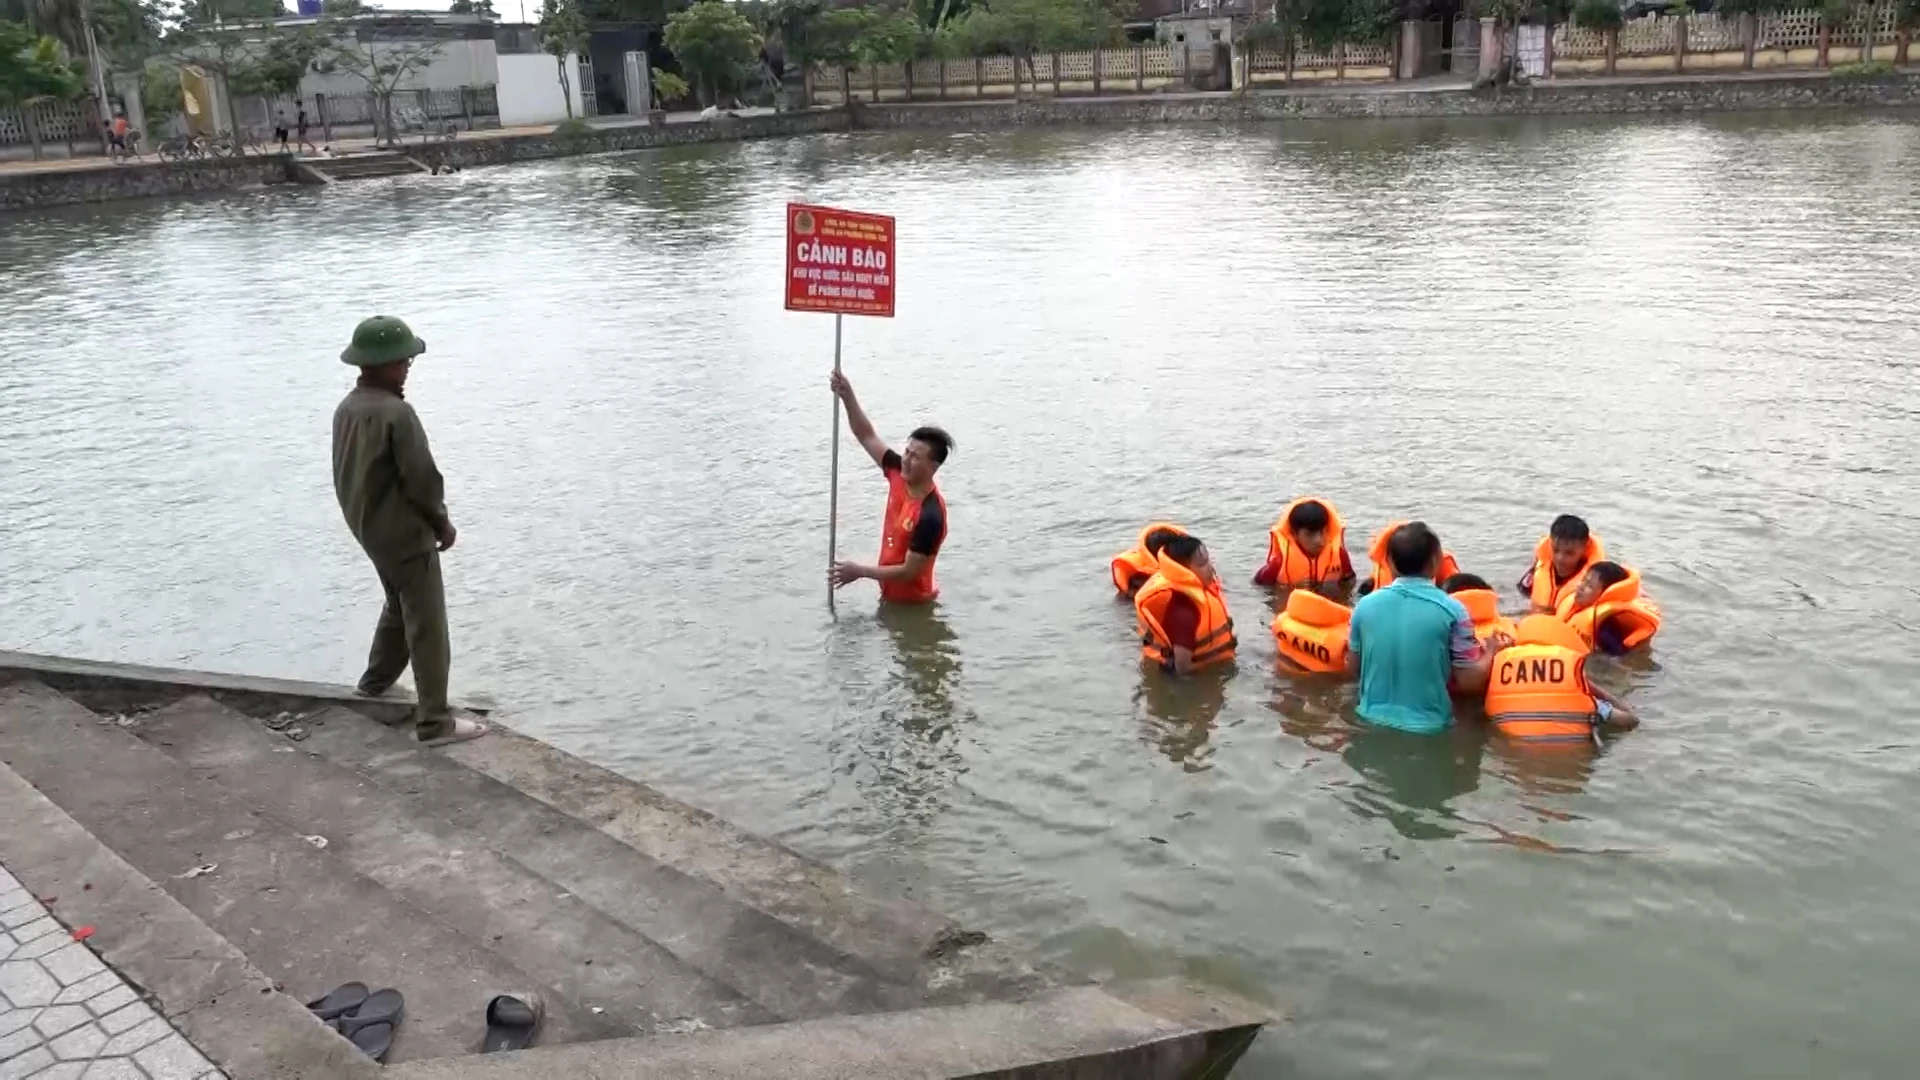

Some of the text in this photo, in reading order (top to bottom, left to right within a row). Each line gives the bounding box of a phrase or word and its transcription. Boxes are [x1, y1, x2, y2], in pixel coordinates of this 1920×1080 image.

[797, 236, 847, 266] CẢNH
[852, 245, 887, 270] BÁO
[793, 267, 808, 279] KHU
[1500, 659, 1565, 685] CAND
